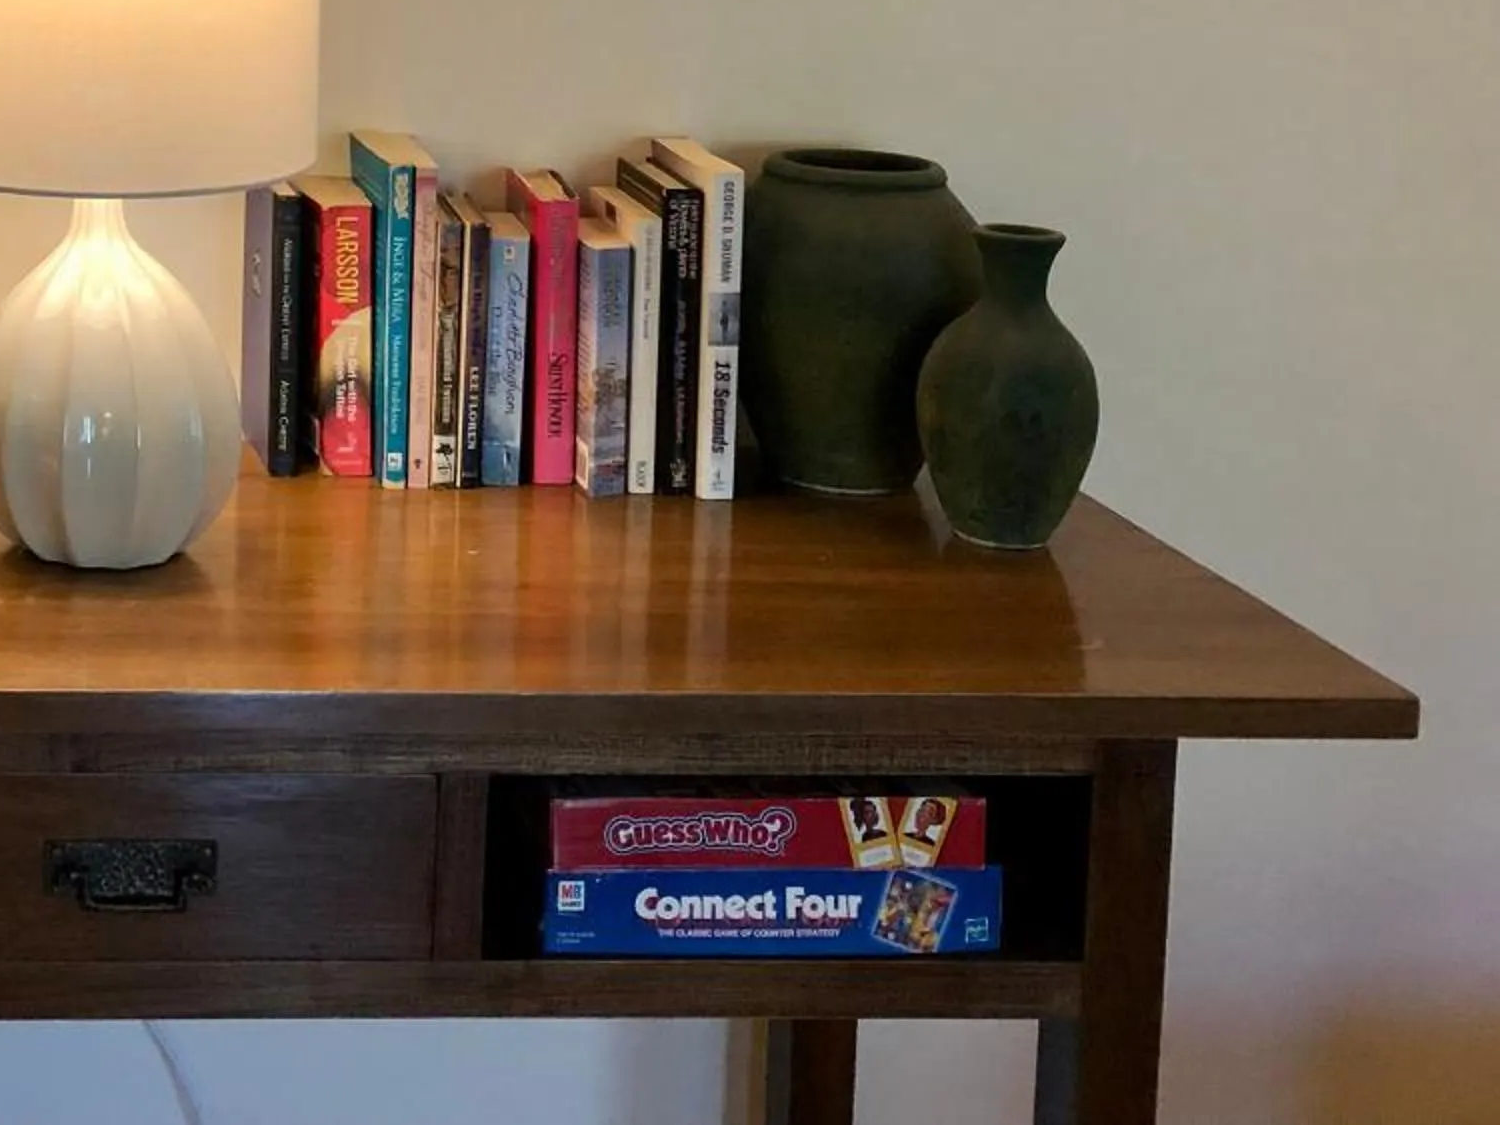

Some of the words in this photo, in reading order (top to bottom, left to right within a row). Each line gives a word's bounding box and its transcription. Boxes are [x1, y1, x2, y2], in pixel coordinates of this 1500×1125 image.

[723, 181, 735, 224] GEORGE
[335, 216, 359, 304] LARSSON
[720, 238, 733, 283] SHUMAN
[713, 360, 731, 382] 18
[712, 388, 731, 454] Seconds
[609, 819, 704, 851] Guess
[704, 809, 793, 852] Who?
[634, 886, 777, 921] Connect
[784, 886, 862, 920] Four
[675, 929, 712, 938] CLASSIC
[714, 929, 738, 938] GAME
